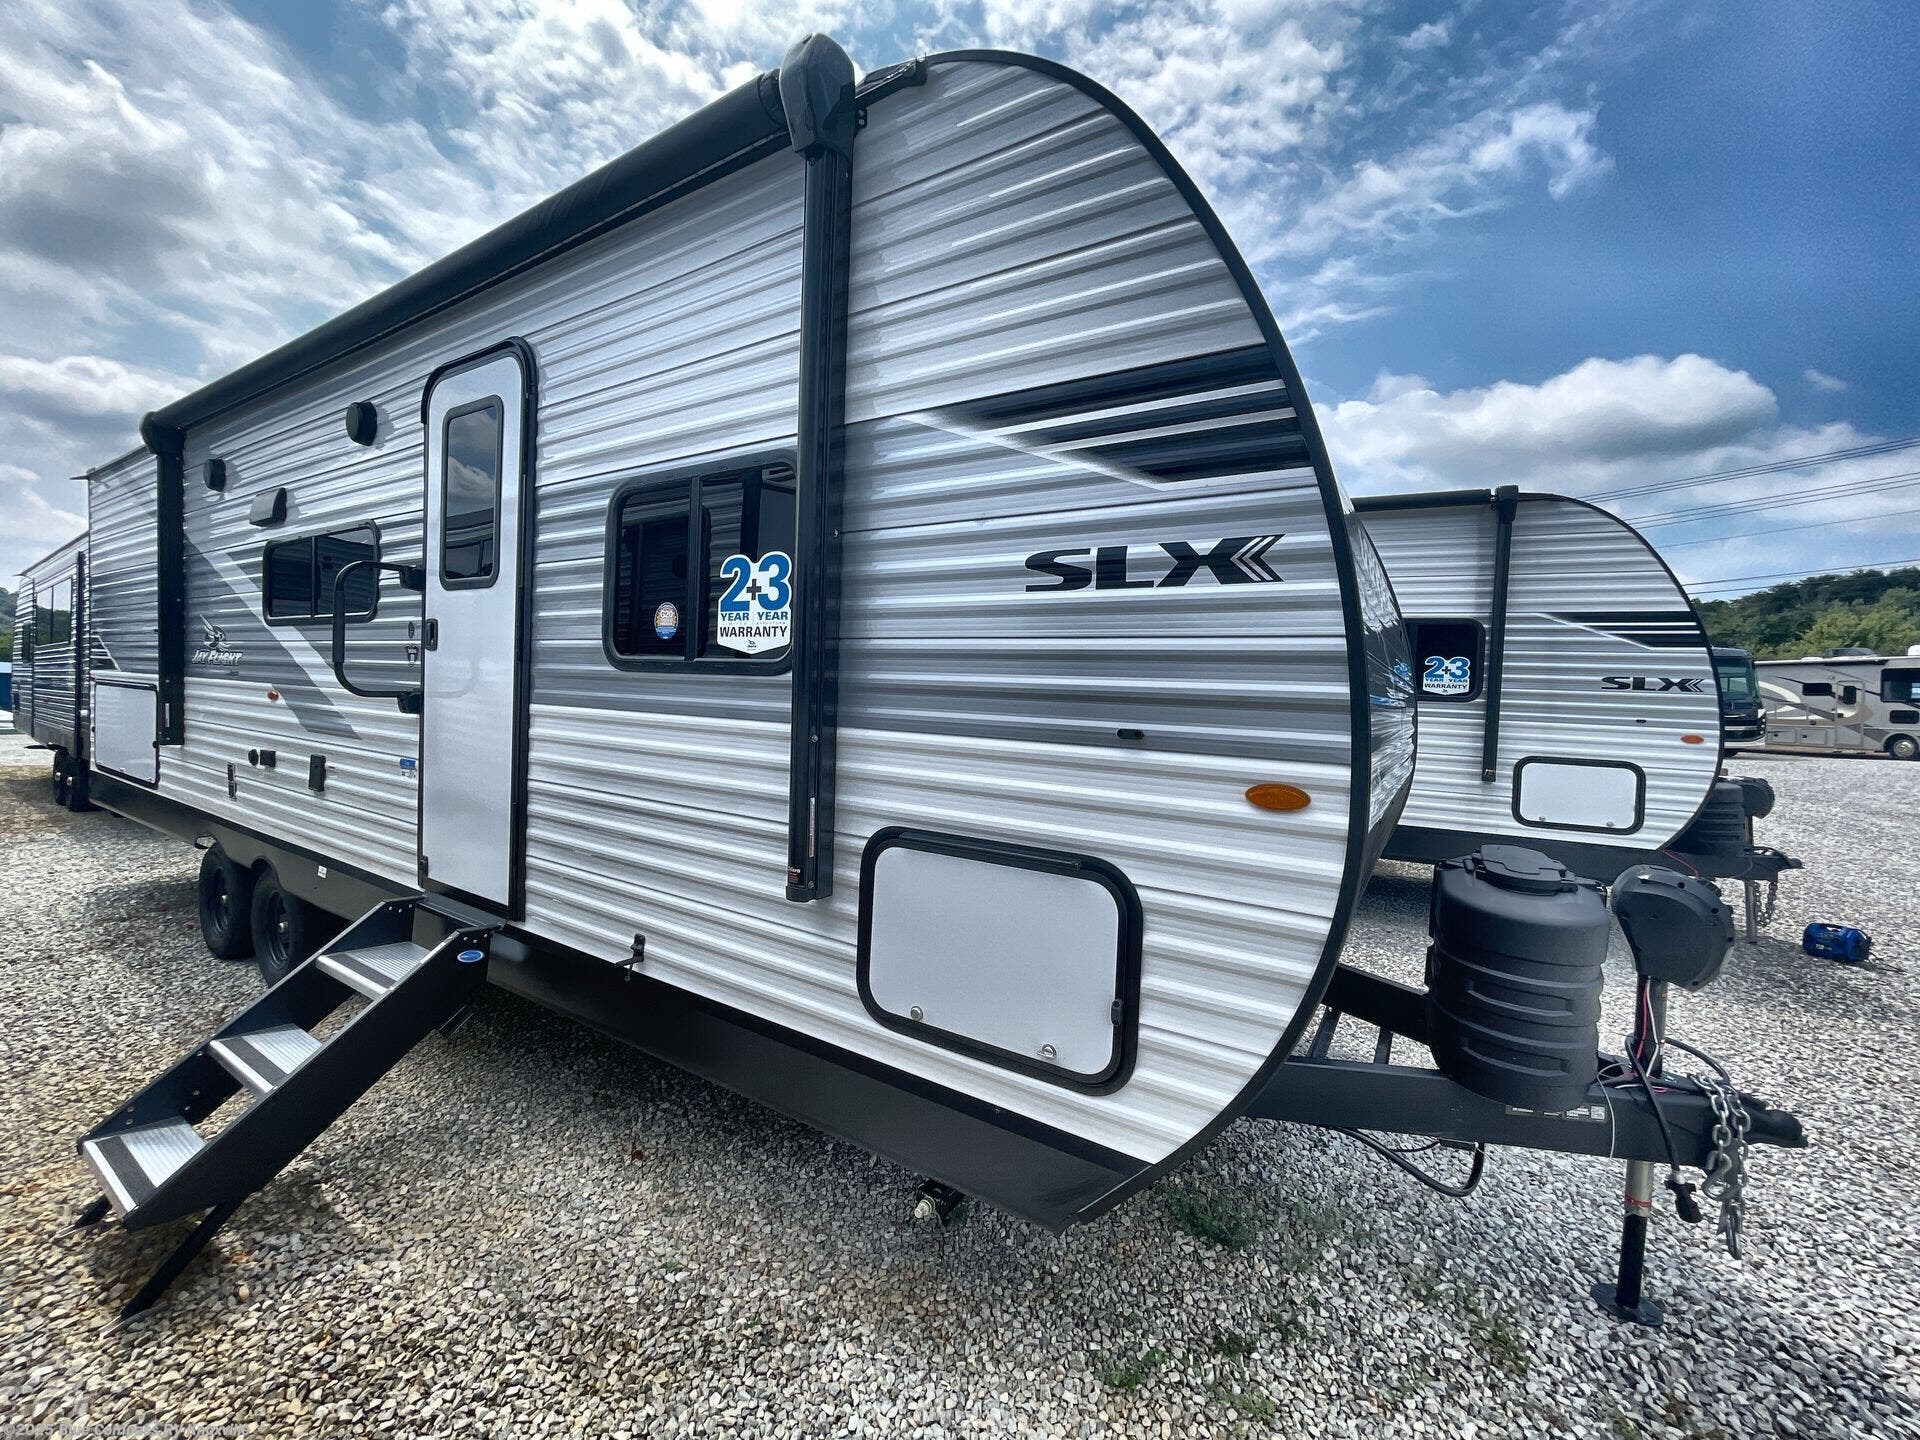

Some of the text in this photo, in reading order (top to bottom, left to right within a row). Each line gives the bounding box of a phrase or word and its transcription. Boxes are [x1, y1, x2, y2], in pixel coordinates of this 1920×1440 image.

[1024, 533, 1286, 592] SLX
[720, 611, 788, 621] YEAR YEAR
[720, 626, 788, 637] WARRANTY
[1424, 682, 1467, 690] WARRANTY
[1601, 676, 1705, 693] SLX
